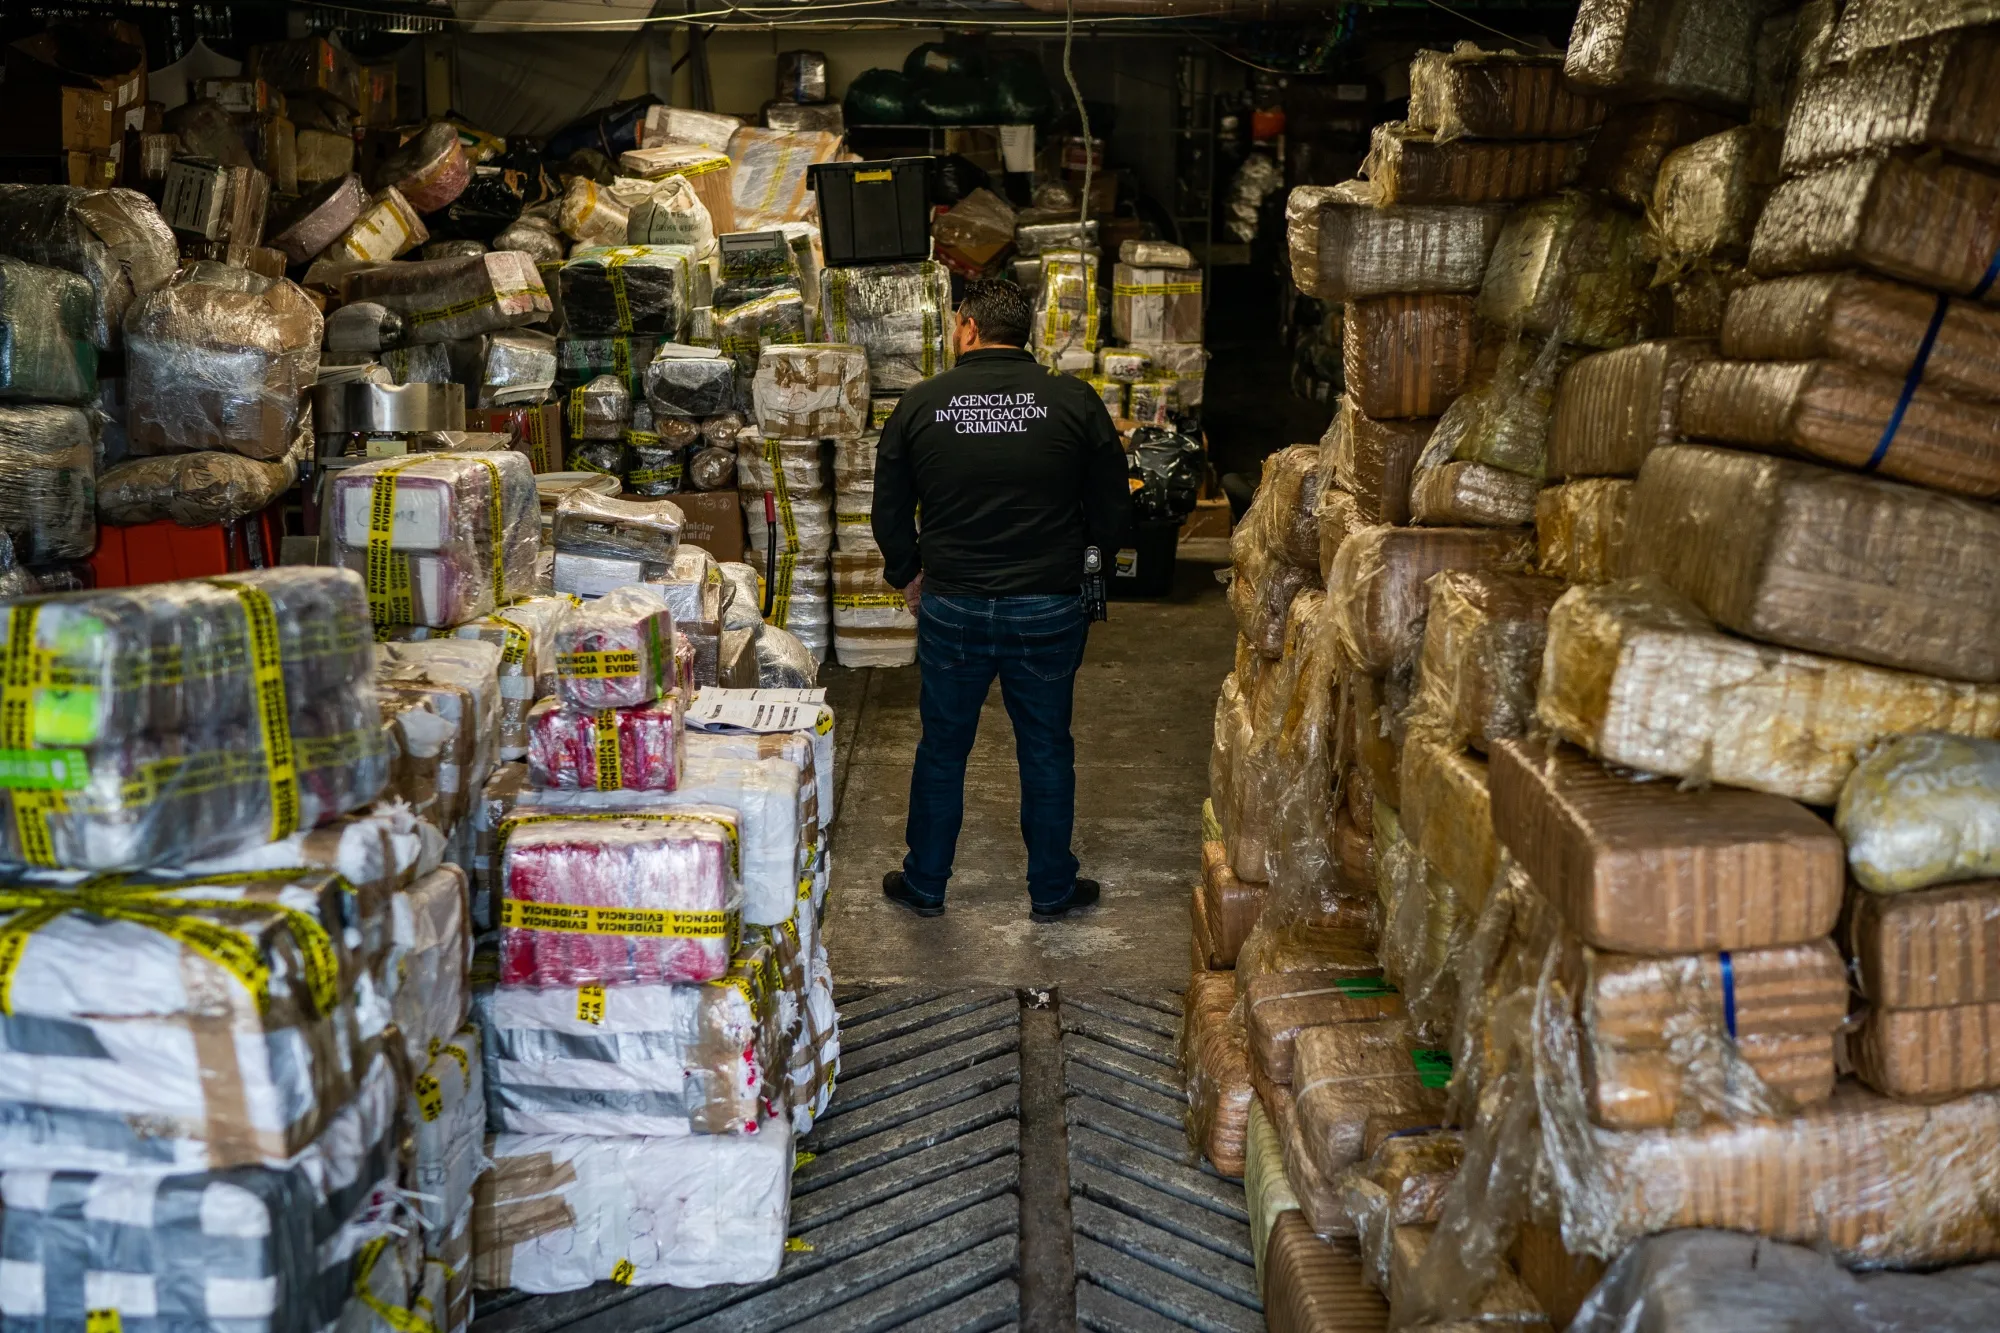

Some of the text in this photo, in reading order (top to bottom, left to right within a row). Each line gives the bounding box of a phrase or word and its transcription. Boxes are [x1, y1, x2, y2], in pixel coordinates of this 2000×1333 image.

[948, 392, 1035, 406] AGENCIA DE
[936, 405, 1048, 422] INVESTIGACIÓN
[956, 420, 1027, 434] CRIMINAL
[373, 475, 384, 531] EVIDENCIA
[381, 475, 394, 532] EVIDENCIA
[370, 538, 379, 594] EVIDENCIA
[378, 538, 388, 595] EVIDENCIA
[604, 654, 638, 663] EVIDE
[606, 664, 639, 674] EVIDE
[522, 904, 588, 918] EVIDENCIA
[598, 911, 664, 922] EVIDENCIA
[522, 915, 588, 930] EVIDENCIA
[597, 922, 664, 933] EVIDENCIA
